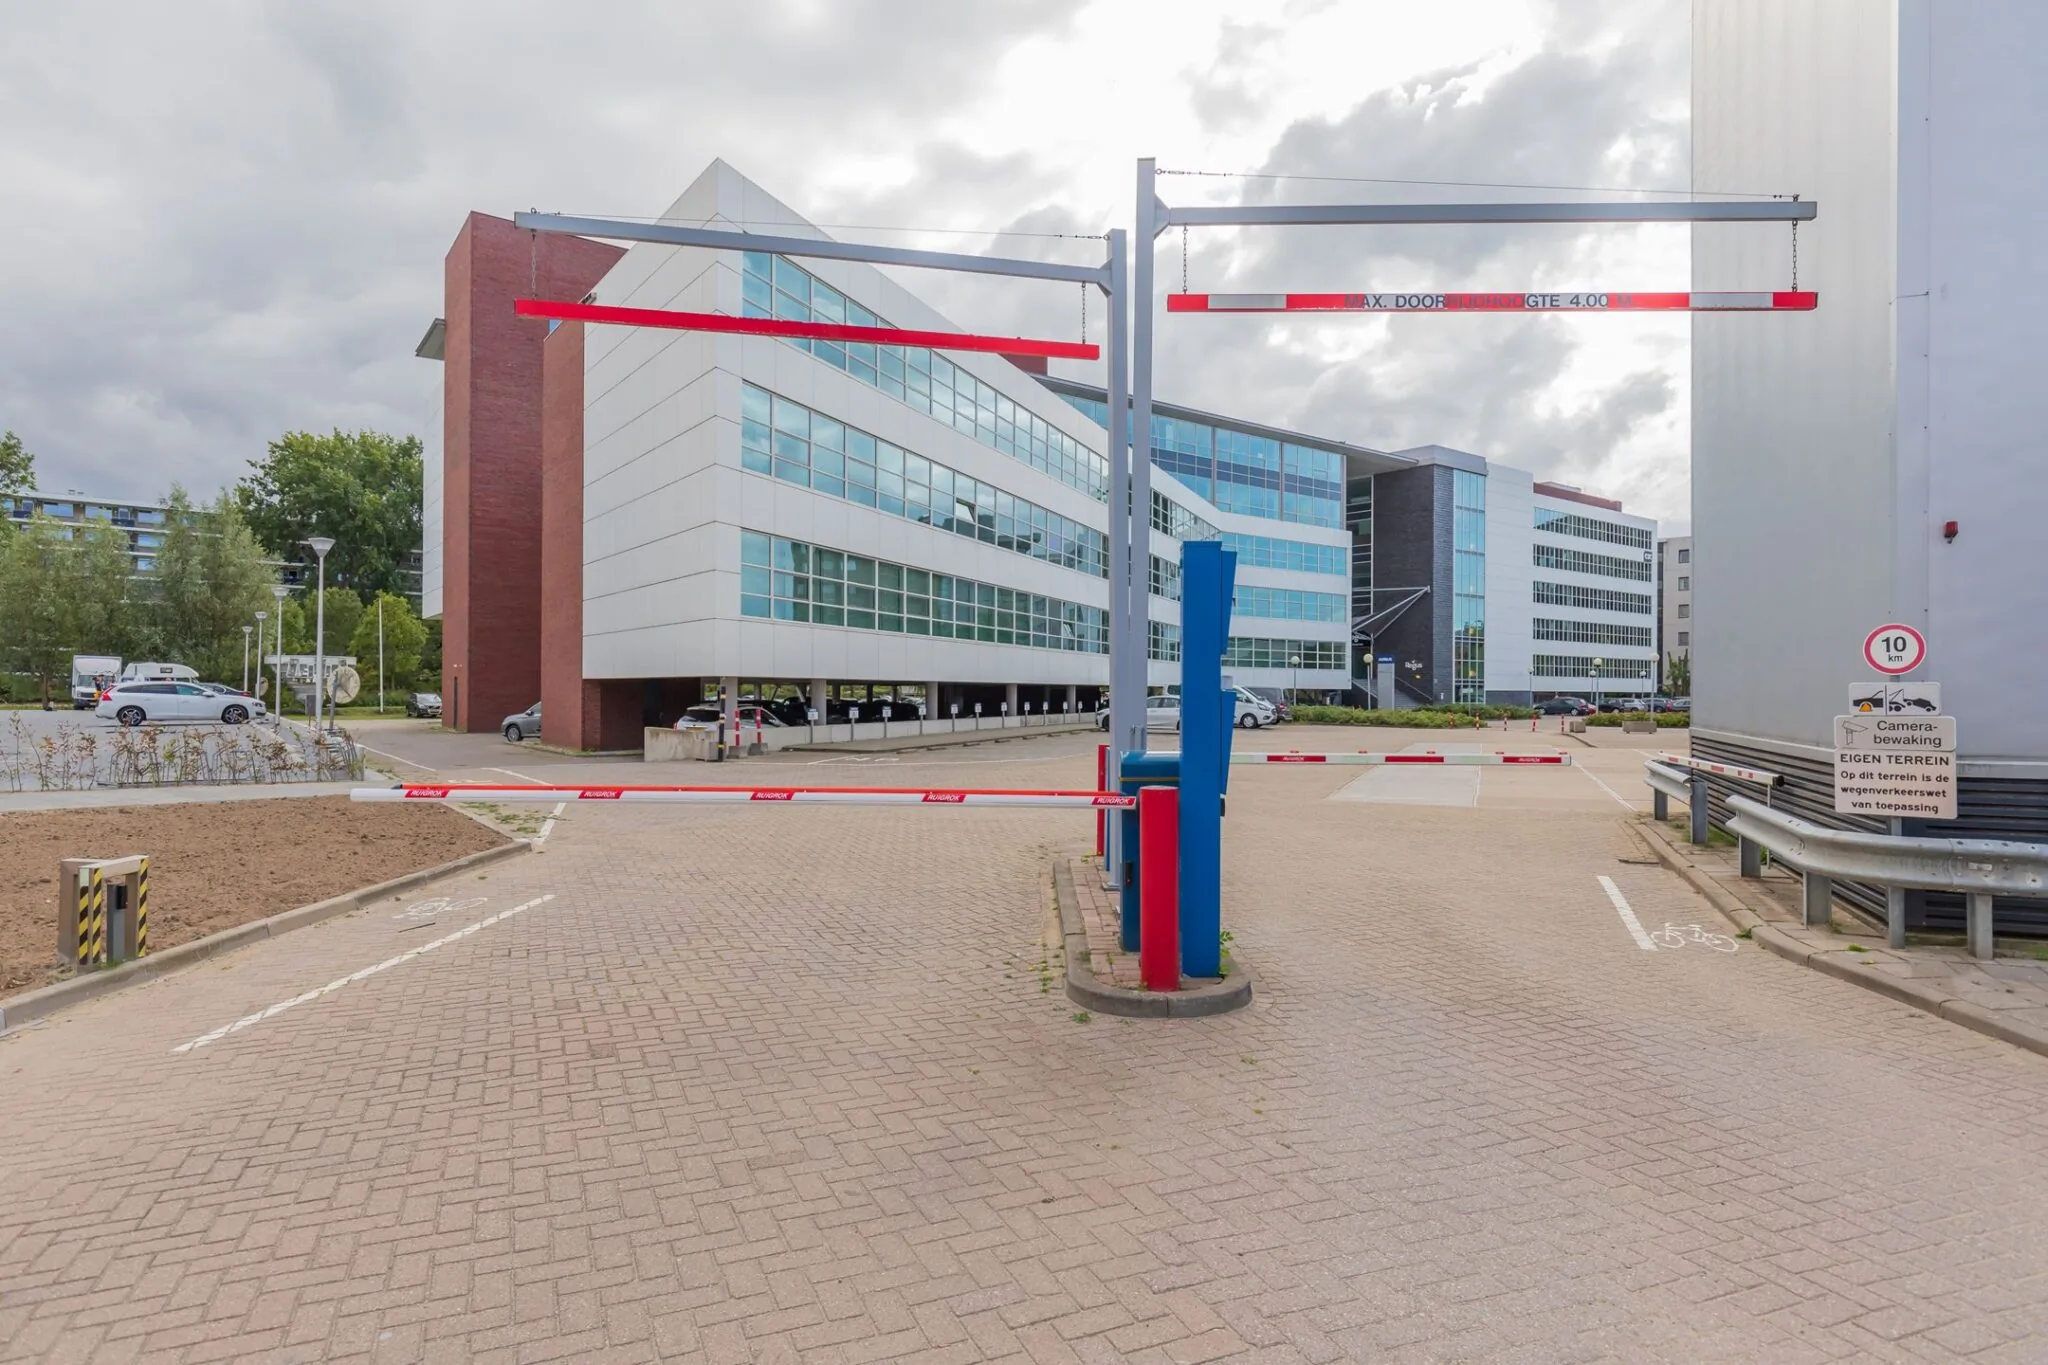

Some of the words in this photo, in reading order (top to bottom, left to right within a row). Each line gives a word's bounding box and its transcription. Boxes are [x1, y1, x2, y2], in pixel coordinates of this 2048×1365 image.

[1569, 294, 1609, 308] 4.00
[1881, 636, 1907, 653] 10
[1888, 653, 1903, 662] km
[1876, 720, 1939, 732] Camera-
[1873, 733, 1942, 748] bewaking
[1840, 753, 1881, 764] EIGEN
[1886, 755, 1949, 766] TERREIN
[1840, 770, 1856, 781] Op
[1859, 771, 1874, 780] dit
[1878, 772, 1918, 782] terrein
[1922, 773, 1932, 782] is
[1935, 774, 1950, 783] de
[1840, 785, 1947, 798] wegenverkeerswet
[1097, 796, 1129, 804] RUIGROK
[1851, 801, 1872, 809] van
[1876, 801, 1939, 815] toepassing
